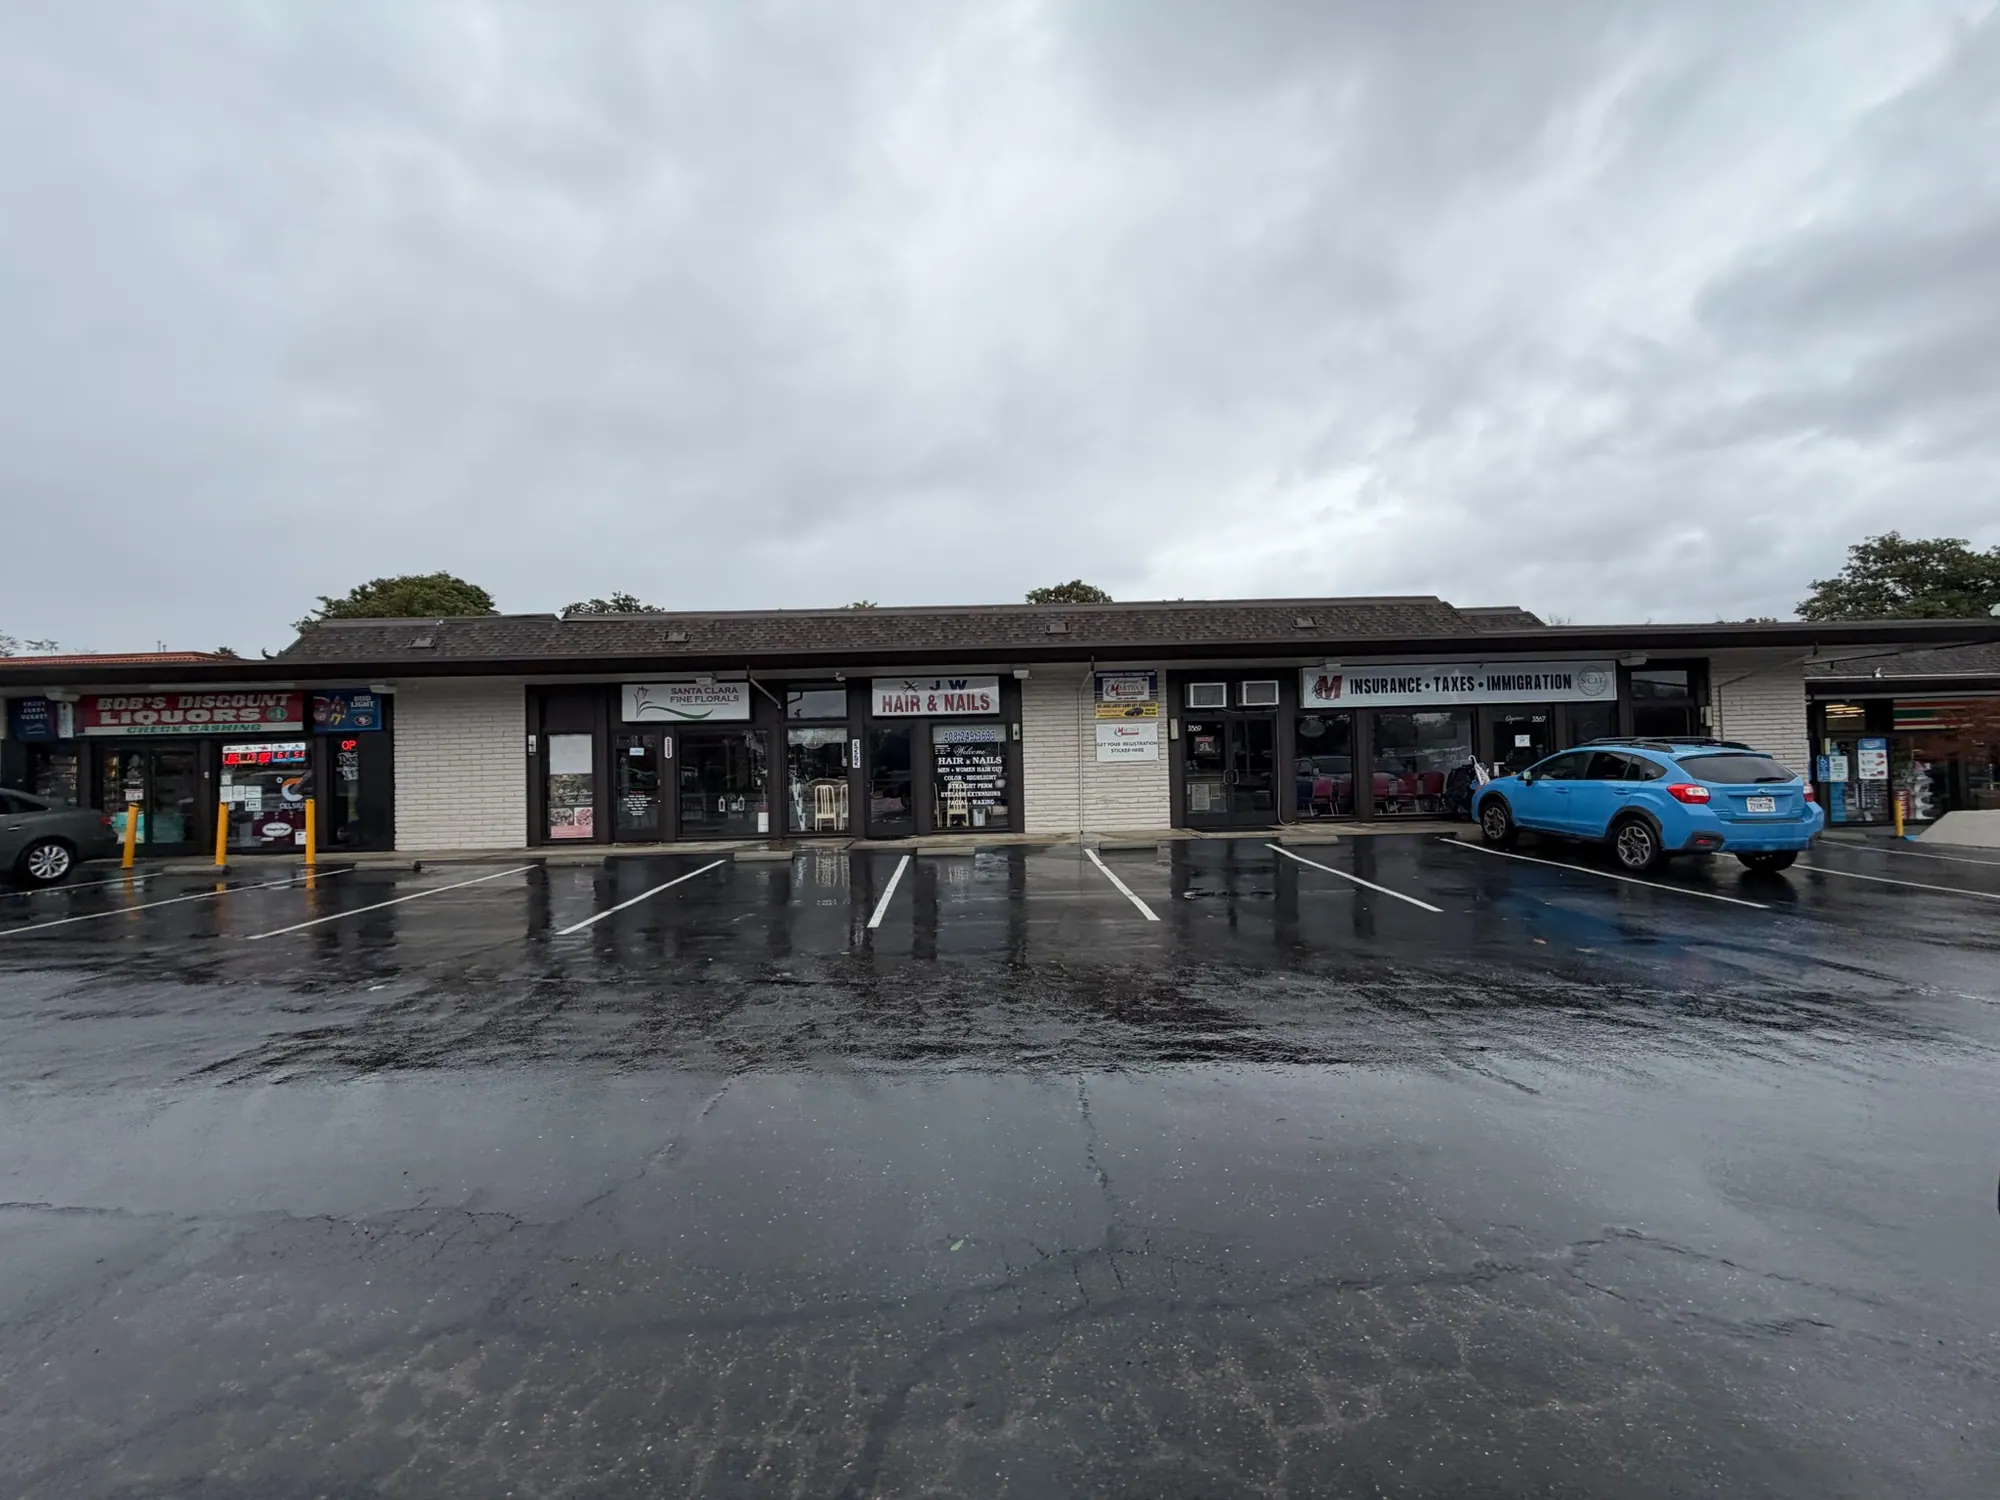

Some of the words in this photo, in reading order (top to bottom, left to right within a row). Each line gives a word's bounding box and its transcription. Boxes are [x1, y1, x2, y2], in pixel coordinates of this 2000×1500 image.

[928, 680, 941, 690] J
[948, 680, 968, 690] W
[1350, 677, 1422, 695] INSURANCE
[1434, 675, 1474, 692] TAXES
[1486, 673, 1572, 691] IMMIGRATION
[670, 687, 703, 695] SANTA
[704, 686, 738, 694] CLARA
[96, 696, 166, 711] BOB'S
[177, 693, 292, 709] DISCOUNT
[670, 695, 693, 703] FINE
[694, 694, 740, 703] FLORALS
[882, 694, 921, 713] HAIR
[927, 694, 938, 712] &
[944, 692, 990, 711] NAILS
[100, 708, 261, 725] LIQUORS
[125, 725, 182, 734] CHECK
[188, 723, 261, 733] CASHING
[952, 744, 986, 757] Welcome
[938, 757, 964, 765] HAIR
[972, 756, 1003, 764] NAILS
